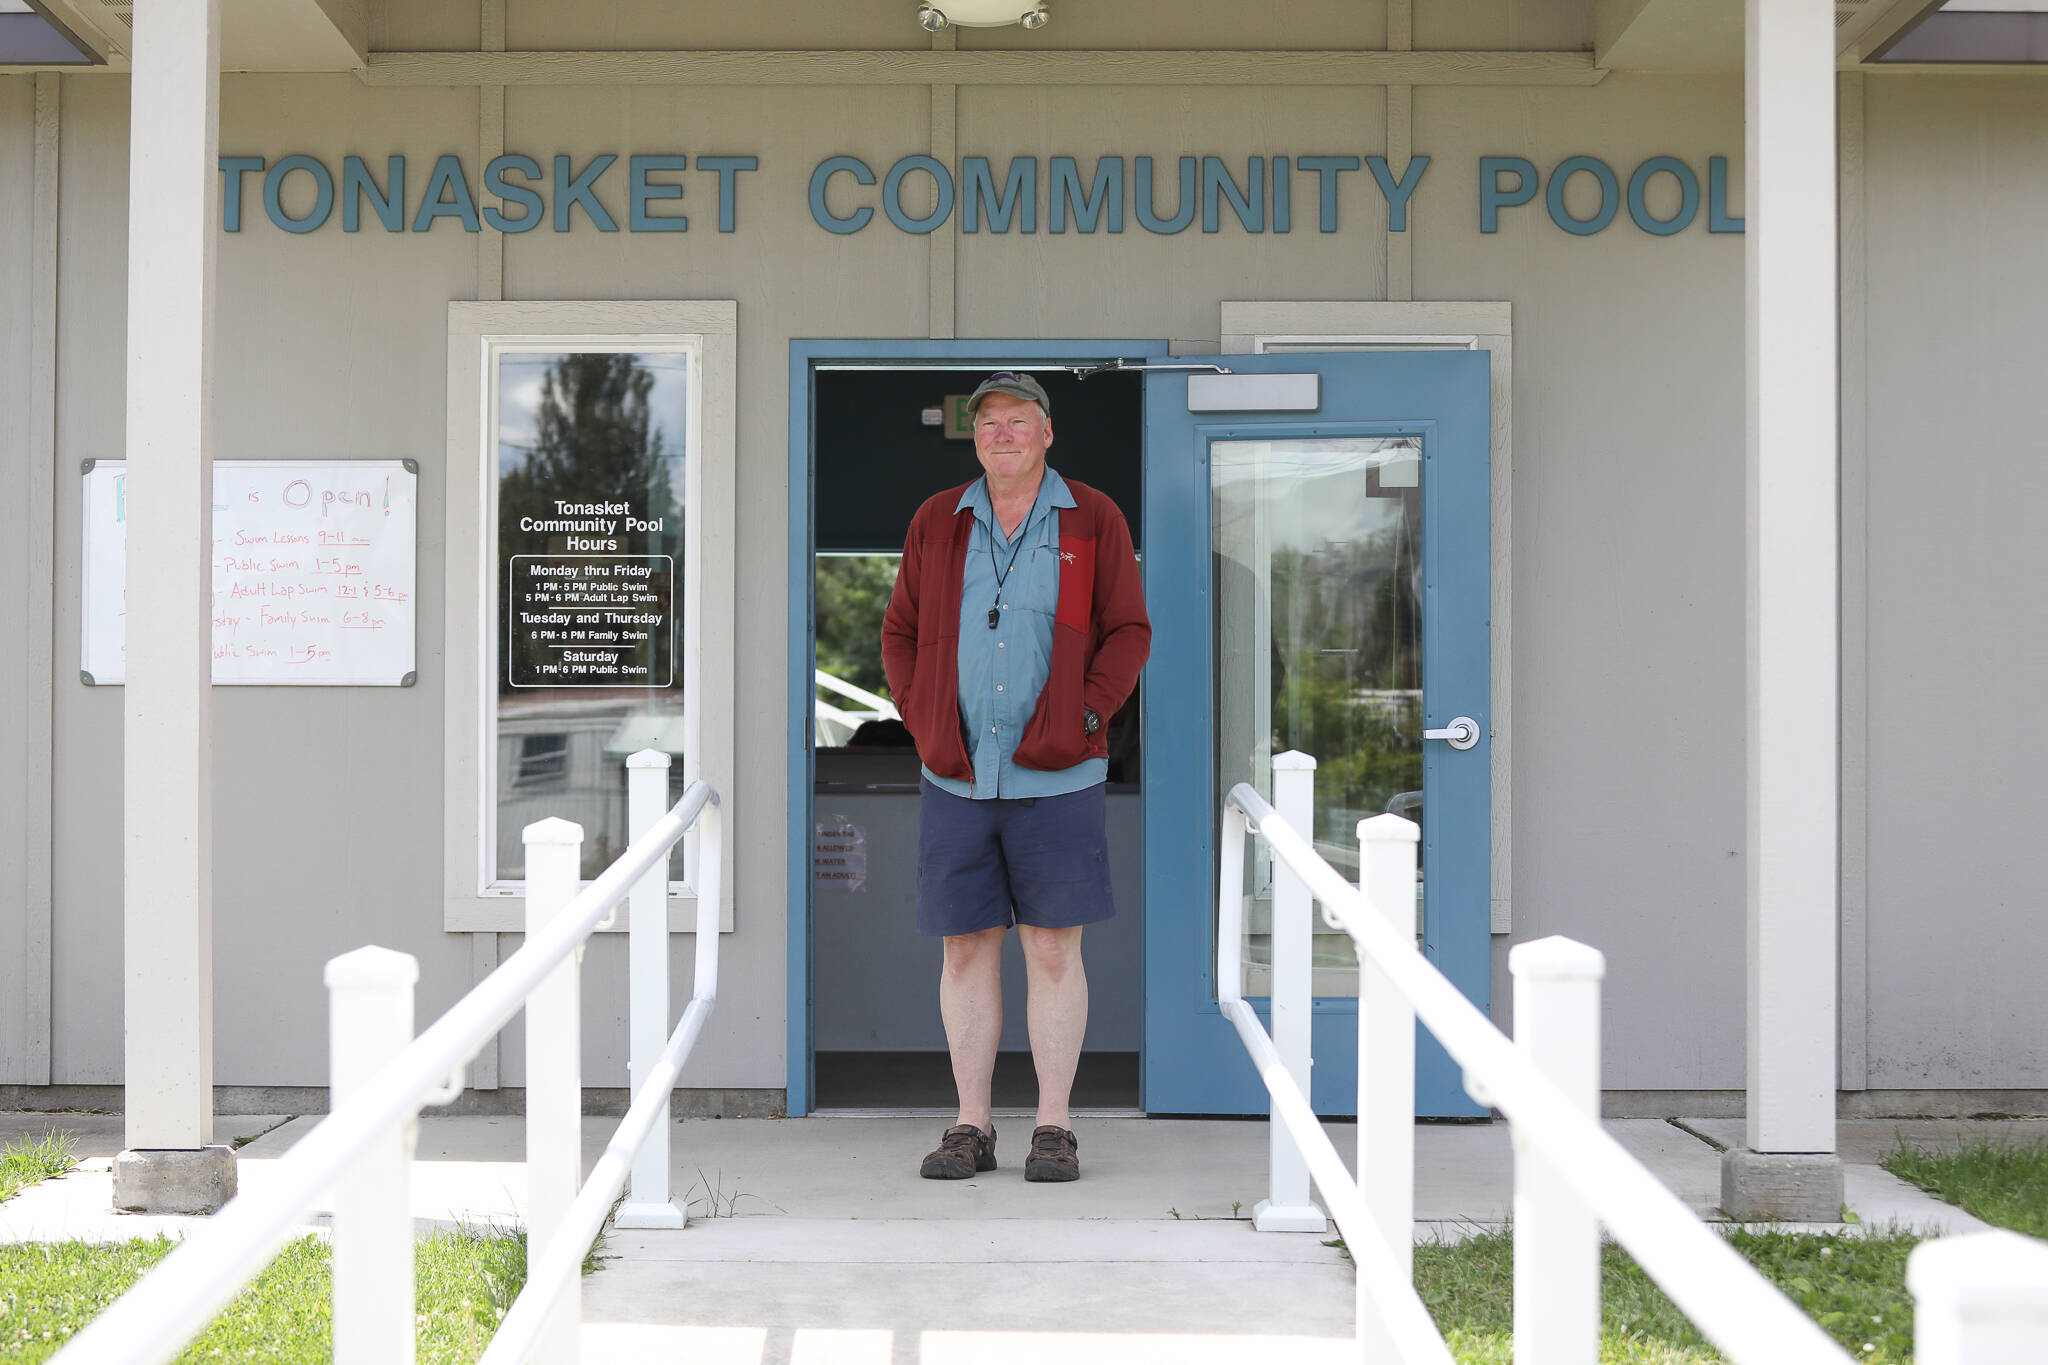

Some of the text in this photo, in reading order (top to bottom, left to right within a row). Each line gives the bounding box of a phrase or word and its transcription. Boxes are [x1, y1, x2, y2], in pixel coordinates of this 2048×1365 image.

[219, 154, 1745, 236] TONASKET COMMUNITY POOL
[249, 491, 260, 502] is
[555, 501, 629, 515] Tonasket
[520, 517, 662, 535] Community Pool
[567, 536, 617, 550] Hours
[225, 558, 264, 572] Public
[270, 559, 299, 571] Swim
[531, 565, 652, 579] Monday thru Friday
[573, 583, 586, 591] PM
[591, 583, 618, 591] Public
[622, 583, 647, 591] Swim
[611, 594, 628, 603] Lap
[520, 613, 662, 626] Tuesday and Thursday
[531, 631, 537, 639] 6
[571, 631, 585, 639] PM
[589, 631, 618, 641] Family
[623, 631, 647, 639] Swim
[564, 651, 618, 664] Saturday
[572, 665, 586, 673] PM
